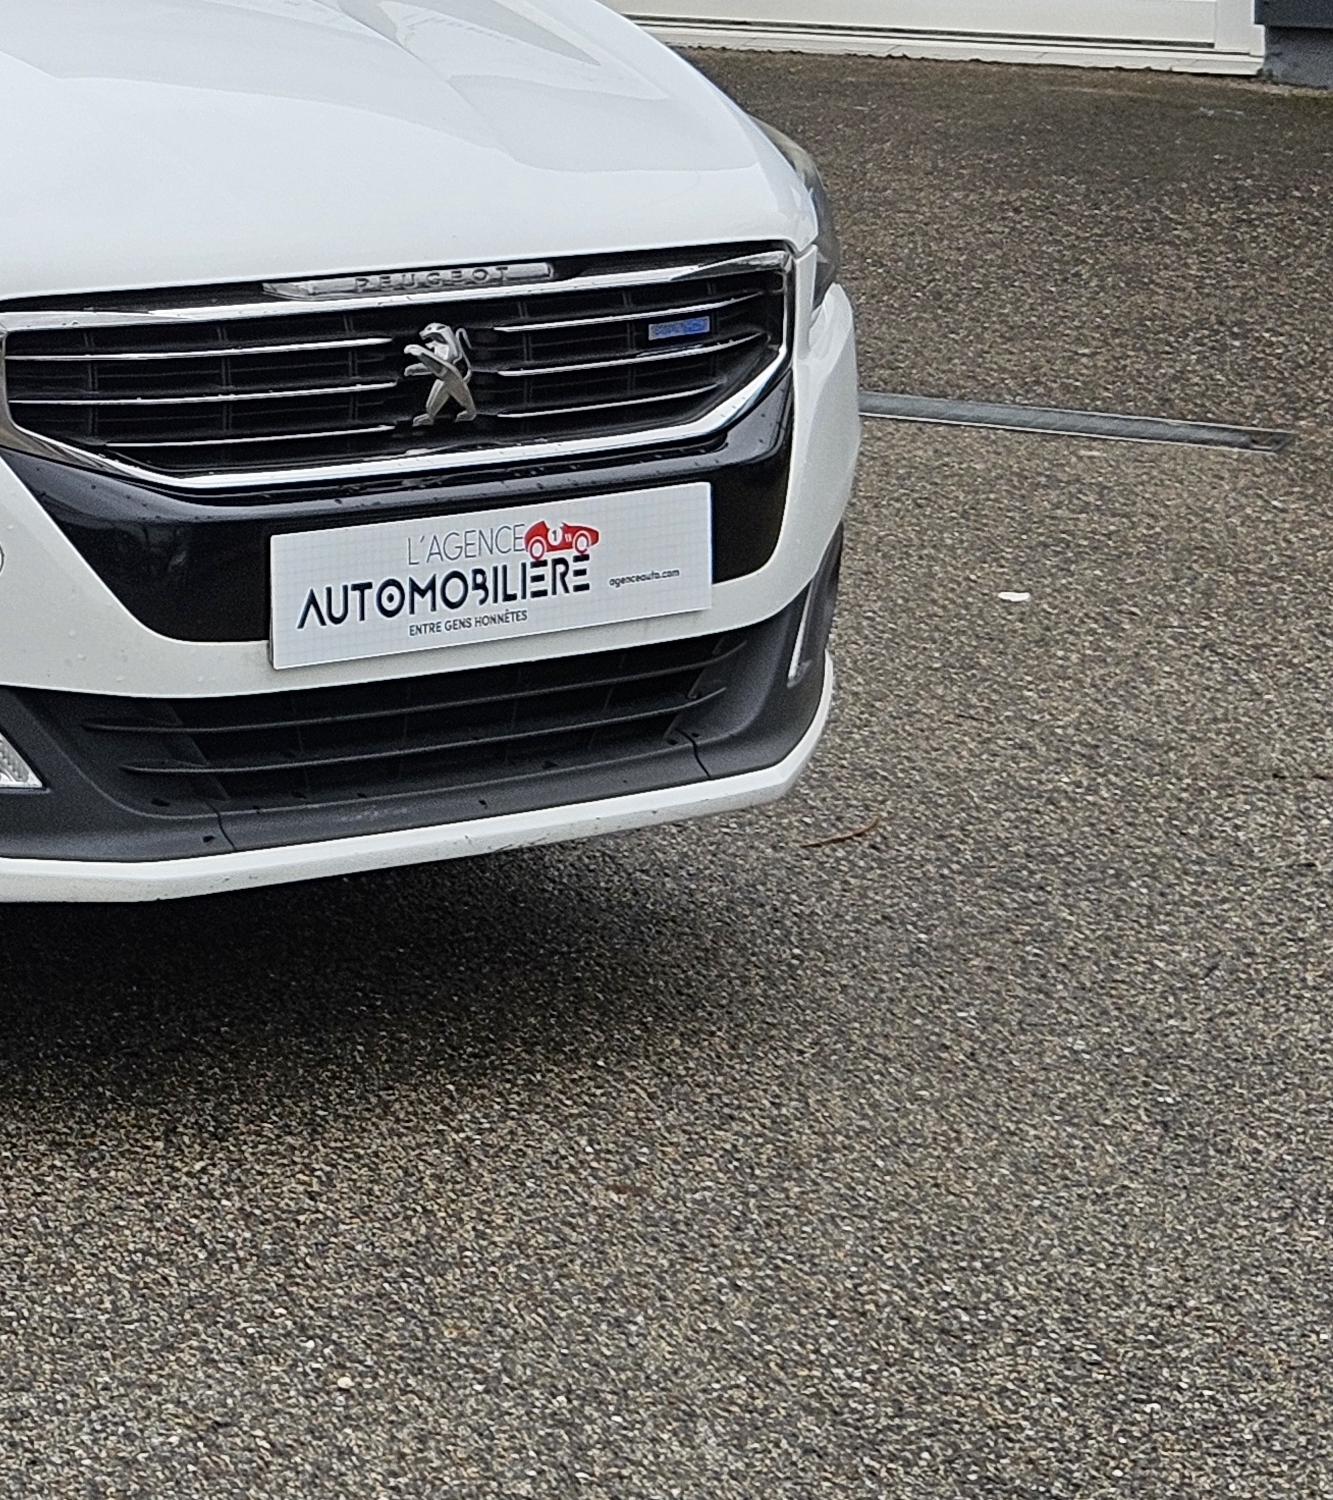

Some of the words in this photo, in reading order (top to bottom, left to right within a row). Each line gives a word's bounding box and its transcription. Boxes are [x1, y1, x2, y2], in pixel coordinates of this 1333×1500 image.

[355, 267, 508, 293] PEUGEOT
[407, 524, 525, 566] L'AGENCE
[609, 568, 680, 588] agenceauto.com
[409, 621, 441, 637] ENTRE
[444, 615, 472, 631] GENS
[474, 608, 528, 627] HONNÊTES
